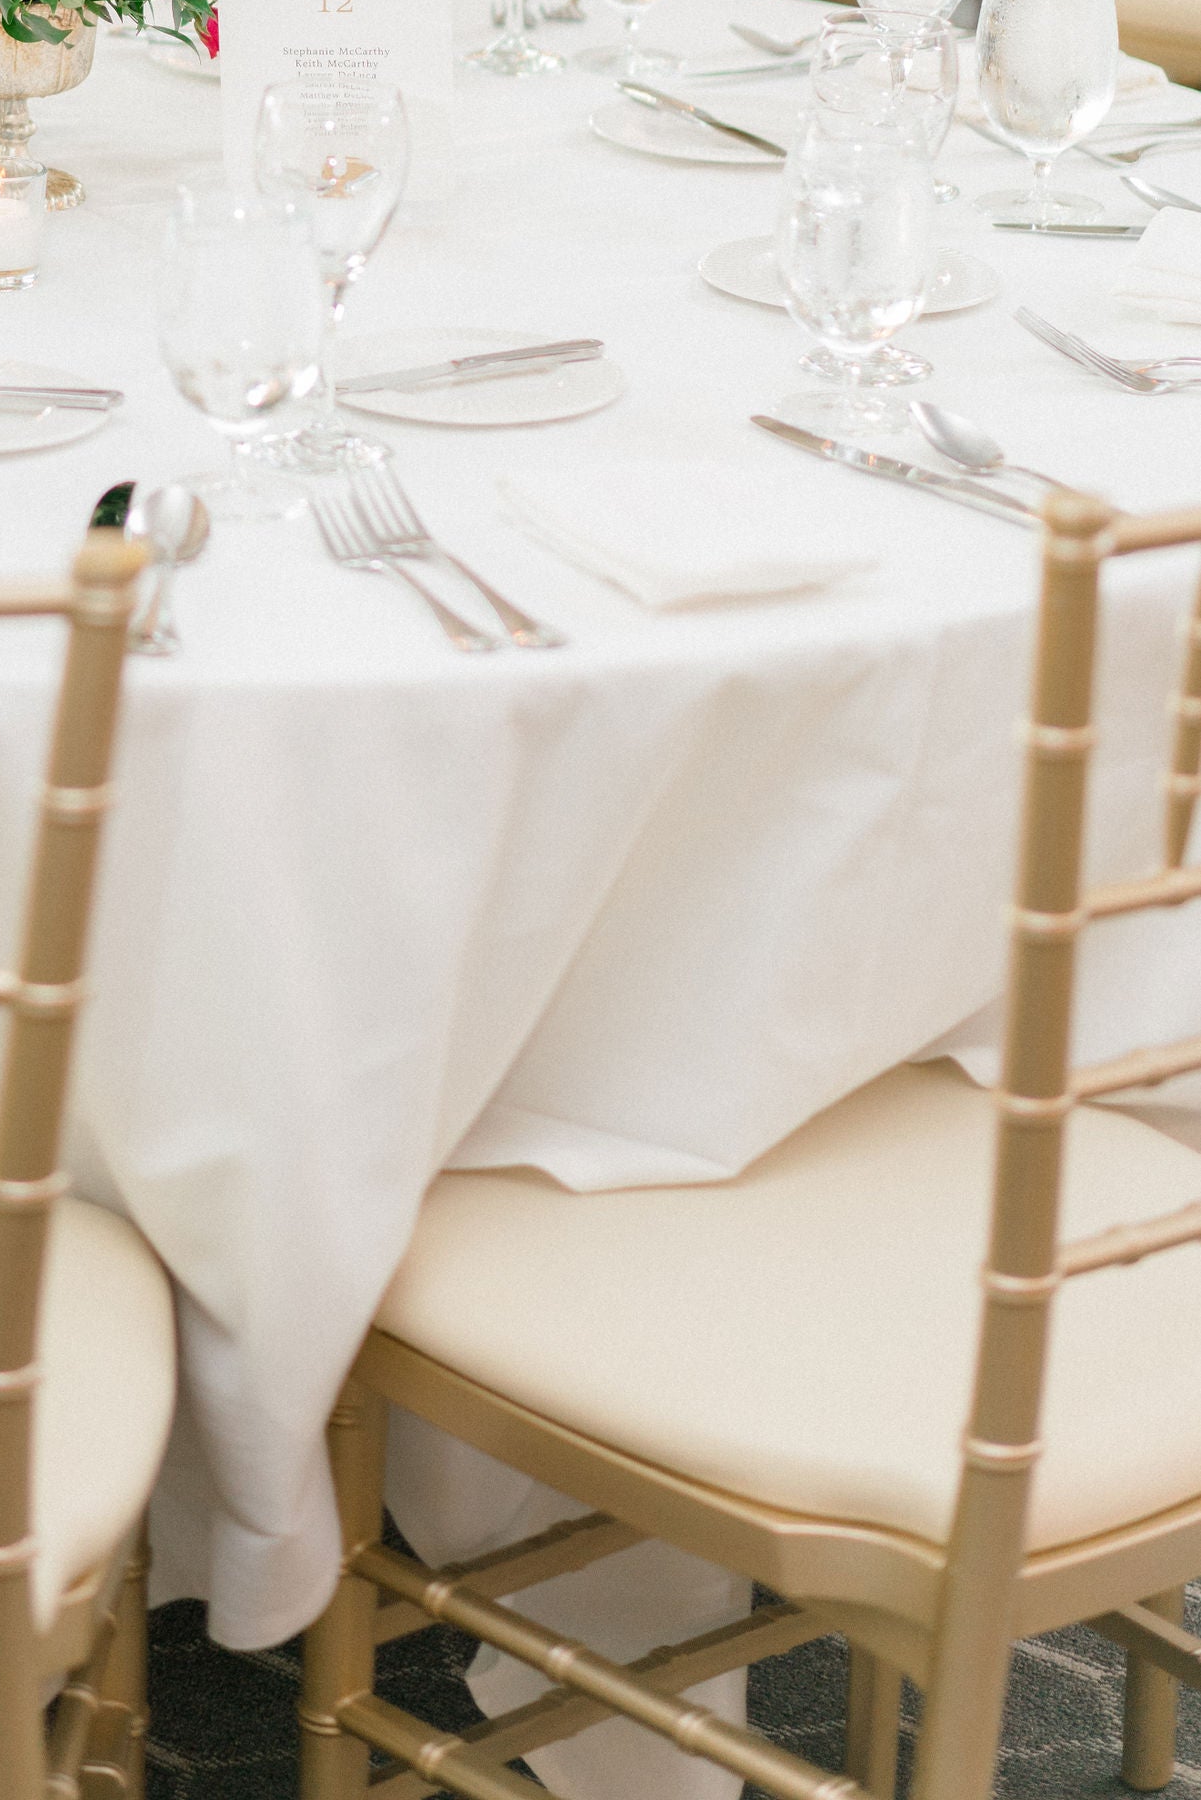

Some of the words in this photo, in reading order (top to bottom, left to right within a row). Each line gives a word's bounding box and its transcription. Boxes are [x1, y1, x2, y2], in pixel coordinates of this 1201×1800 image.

[282, 46, 335, 58] Stephanie
[338, 46, 391, 58] McCarthy
[295, 59, 323, 68] Keith
[327, 59, 379, 70] McCarthy
